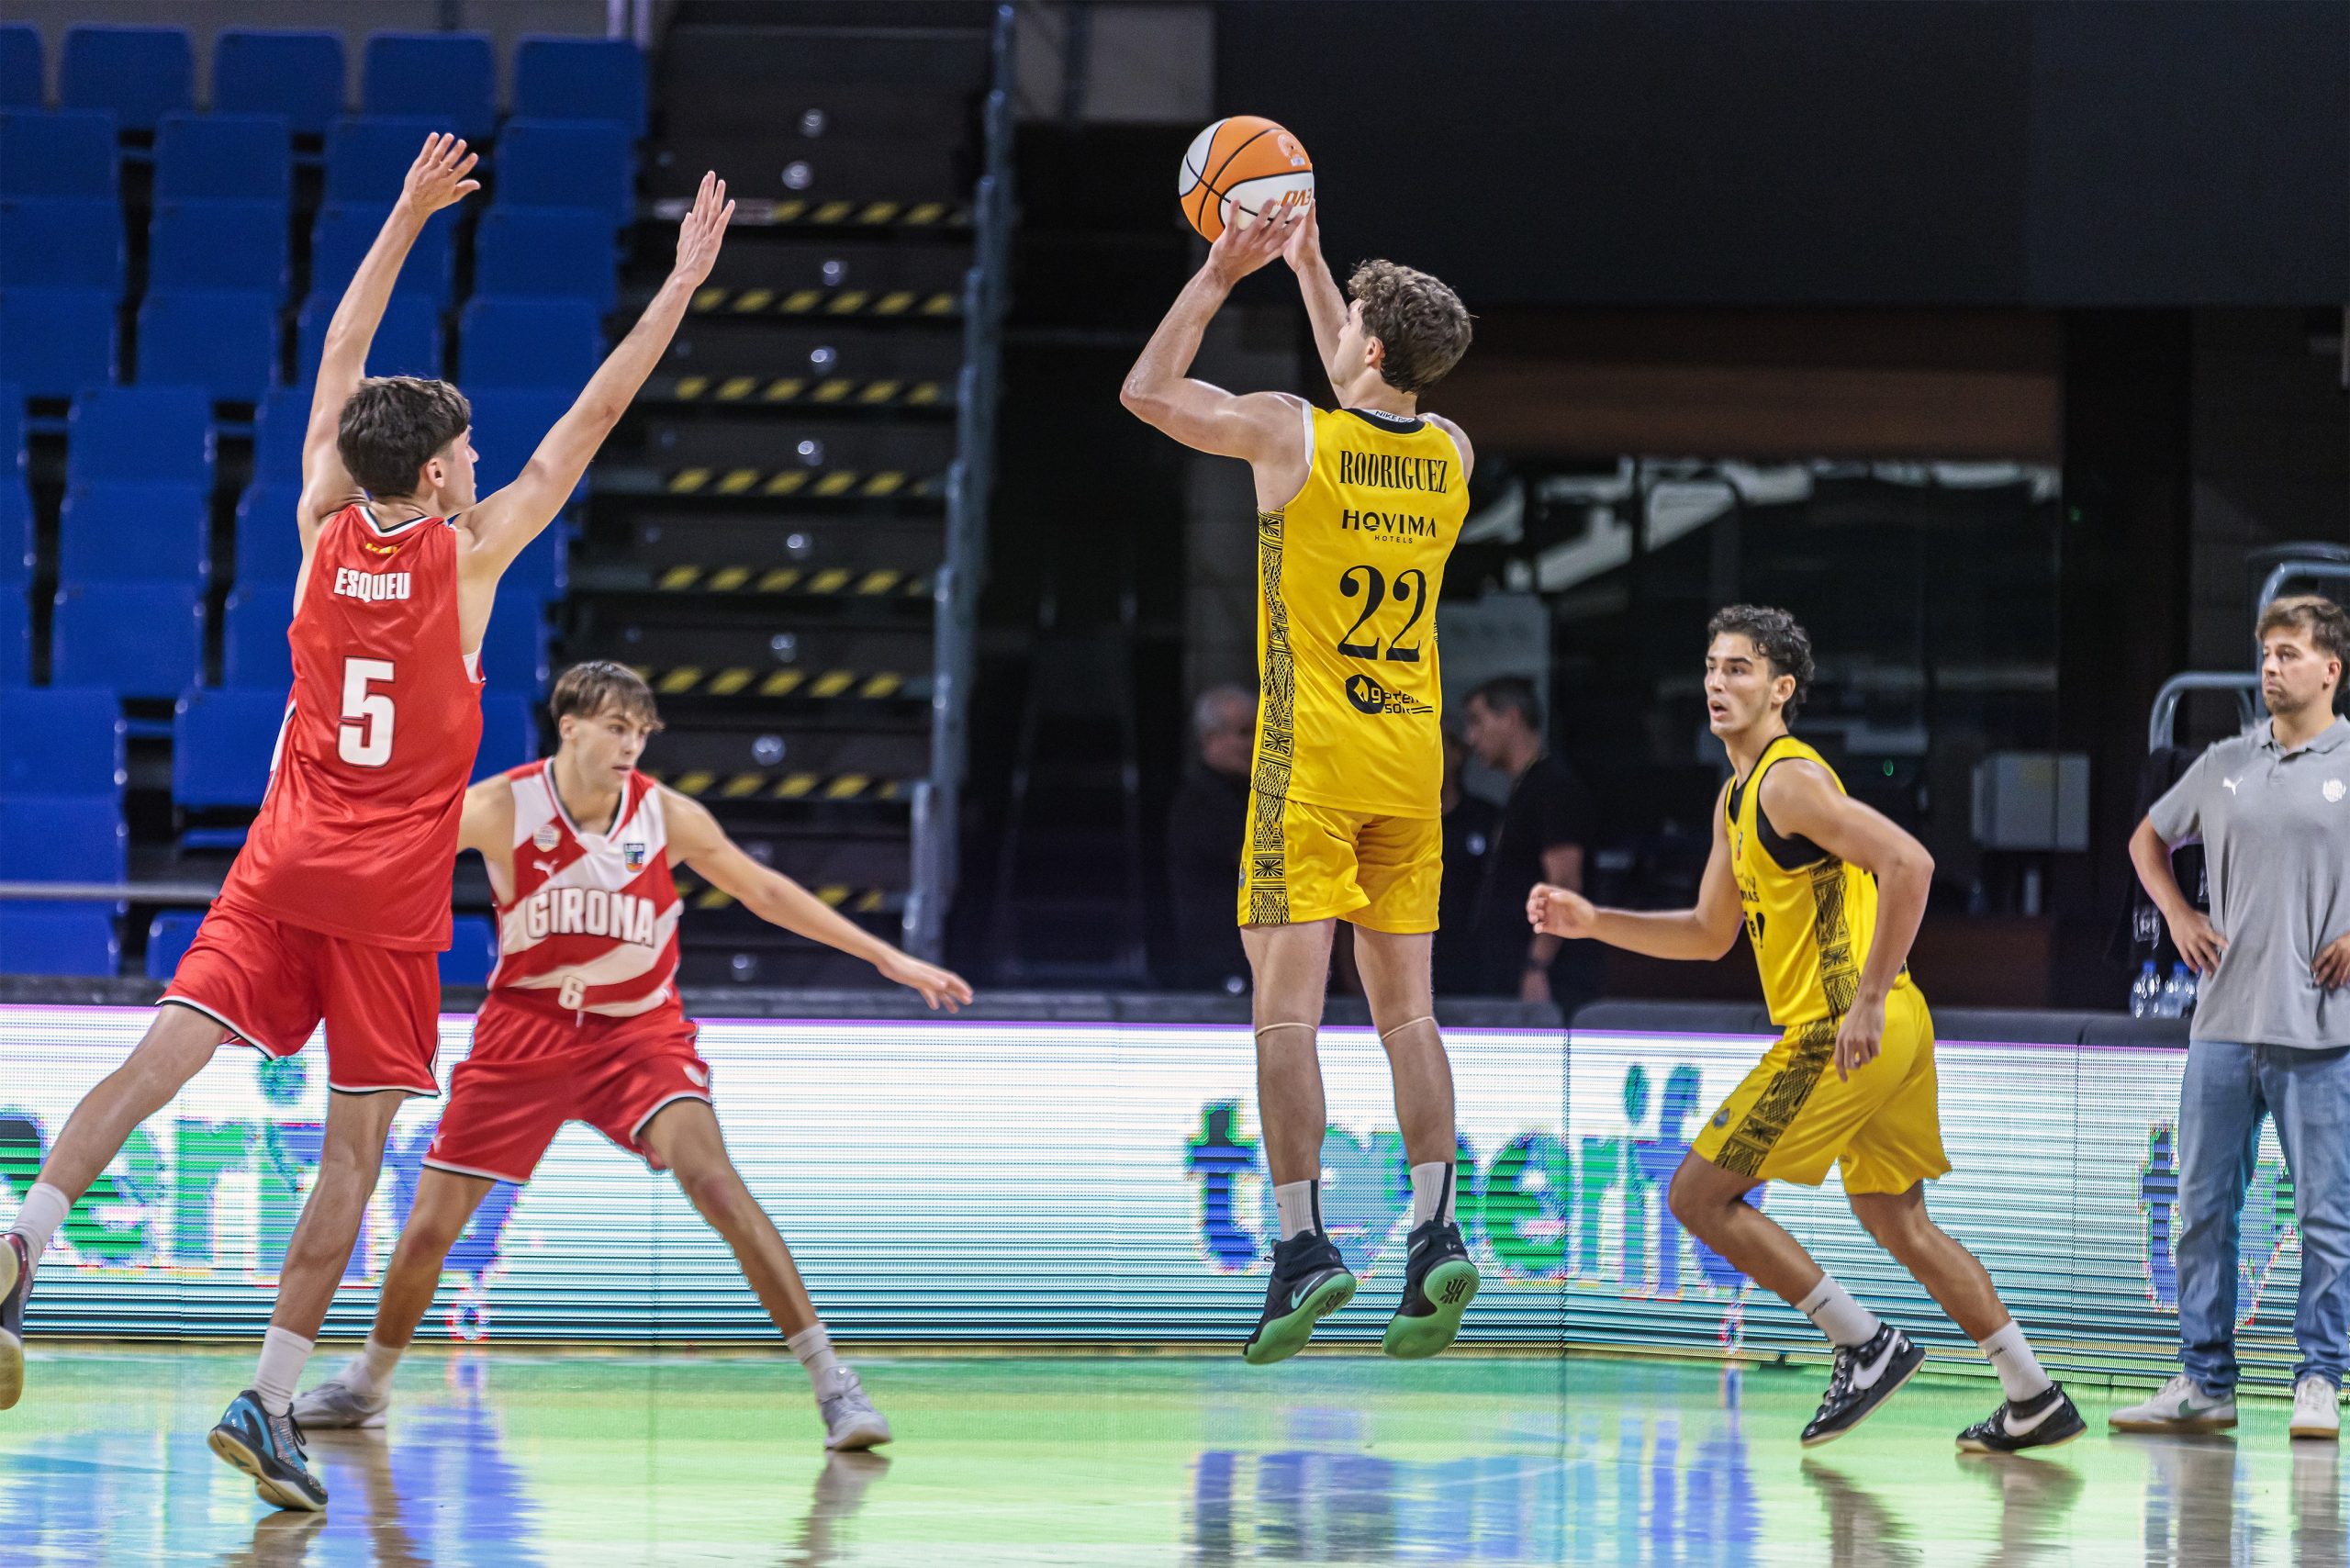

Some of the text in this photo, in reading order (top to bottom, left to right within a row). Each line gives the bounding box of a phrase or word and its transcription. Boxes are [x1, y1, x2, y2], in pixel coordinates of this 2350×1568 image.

[1375, 410, 1397, 420] NIKE
[1339, 450, 1448, 494] RODRIGUEZ
[1342, 509, 1437, 538] HOVIMA
[1374, 534, 1414, 544] HOTELS
[333, 566, 411, 603] ESQUEU
[1337, 565, 1427, 663] 22
[338, 655, 396, 769] 5
[526, 887, 655, 949] GIRONA
[558, 975, 587, 1011] 6
